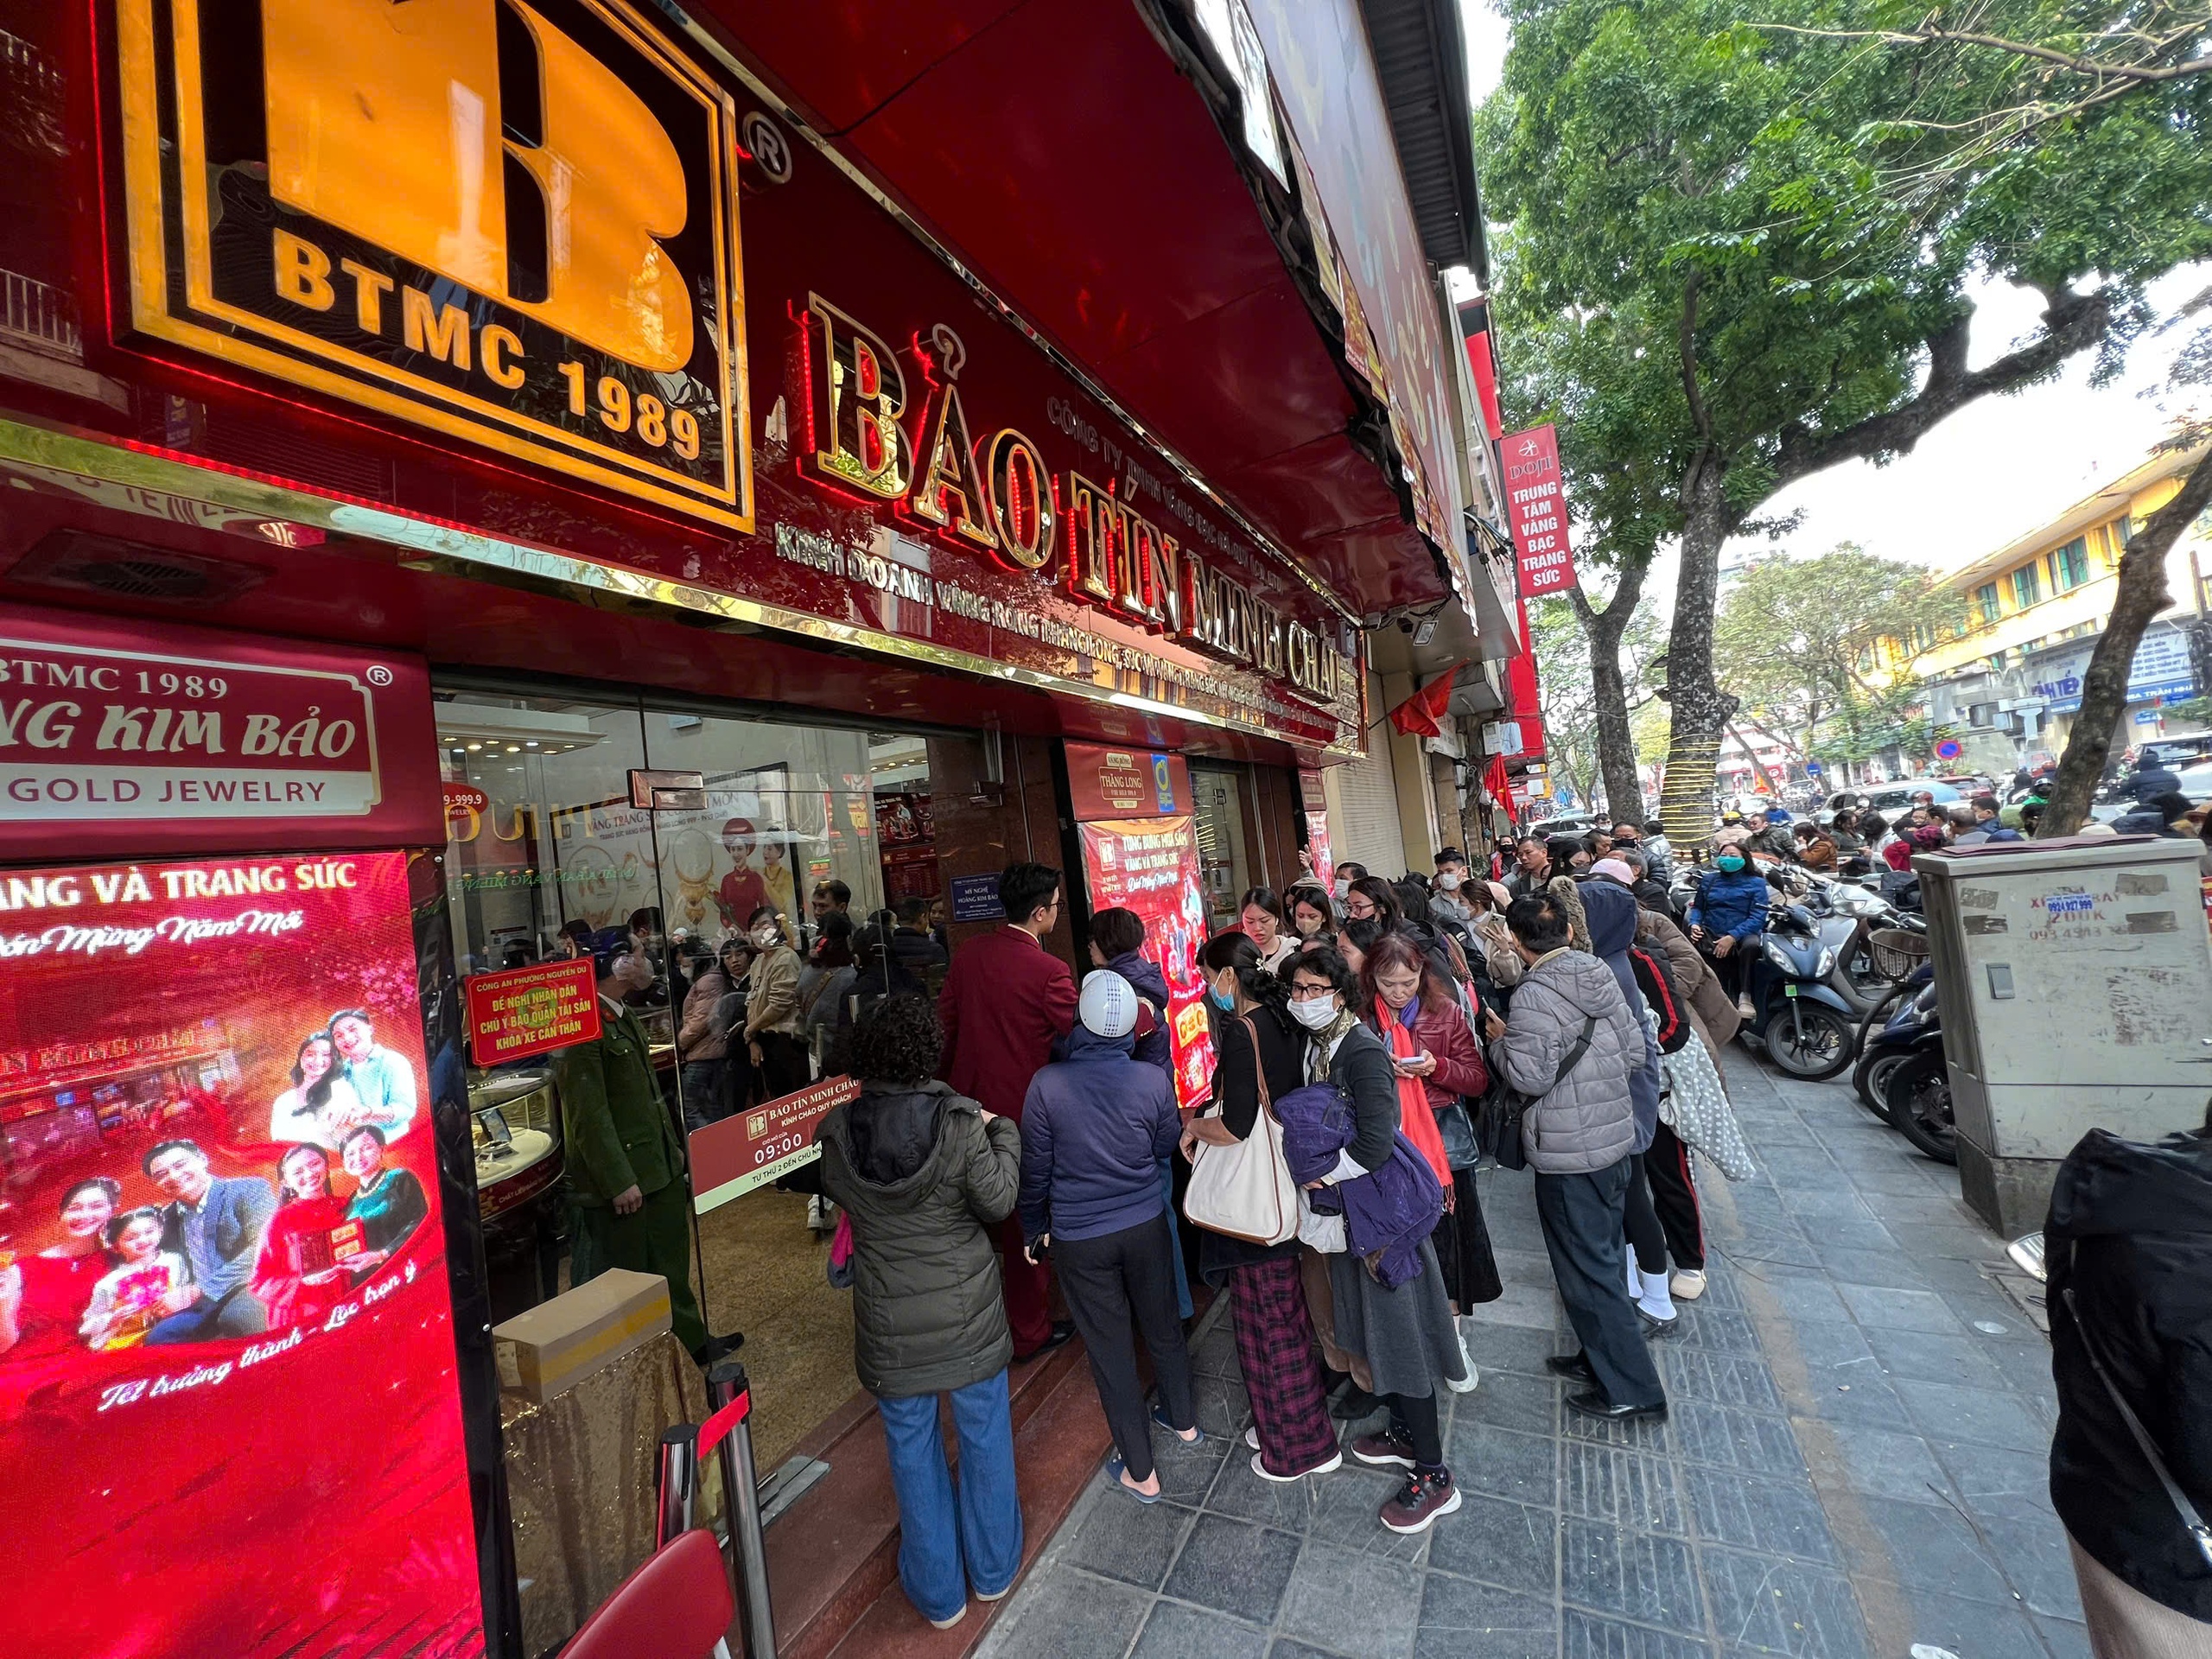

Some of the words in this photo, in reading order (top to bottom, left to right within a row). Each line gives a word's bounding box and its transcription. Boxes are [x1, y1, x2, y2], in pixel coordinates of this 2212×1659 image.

[273, 227, 525, 390] BTMC
[558, 360, 701, 461] 1989
[1046, 396, 1099, 453] CÔNG
[1101, 435, 1122, 471] TY
[1509, 455, 1554, 480] DOJI
[809, 290, 1056, 570] BẢO
[1070, 469, 1181, 632] TÍN
[1186, 549, 1285, 678] MINH
[1512, 481, 1557, 504] TRUNG
[1522, 499, 1552, 519] TÂM
[1521, 516, 1558, 537] VÀNG
[1528, 534, 1555, 554] BẠC
[774, 521, 845, 576] KINH
[848, 547, 934, 606] DOANH
[1522, 550, 1567, 572] TRANG
[1533, 568, 1560, 588] SỨC
[0, 658, 120, 691] BTMC
[135, 671, 228, 699] 1989
[96, 704, 226, 754] KIM
[241, 706, 356, 758] BẢO
[8, 778, 141, 802] GOLD
[158, 779, 326, 803] JEWELRY
[1100, 773, 1124, 788] THĂNG
[1125, 776, 1142, 789] LONG
[90, 867, 153, 903] VÀ
[159, 866, 286, 899] TRANG
[295, 858, 357, 891] SỨC
[156, 916, 238, 944] Năm
[477, 982, 499, 992] CÔNG
[532, 988, 557, 1003] NHÂN
[560, 984, 577, 997] DÂN
[480, 1020, 500, 1034] CHÚ
[502, 1016, 510, 1029] Ý
[531, 1006, 557, 1023] QUẢN
[557, 1003, 572, 1016] TÀI
[574, 998, 591, 1014] SẢN
[524, 1032, 537, 1044] XE
[558, 1020, 582, 1036] THẬN
[769, 1103, 791, 1121] BẢO
[791, 1096, 808, 1111] TÍN
[810, 1087, 834, 1103] MINH
[835, 1077, 860, 1094] CHÂU
[781, 1114, 798, 1128] KÍNH
[798, 1107, 817, 1121] CHÀO
[817, 1101, 831, 1112] QUÝ
[830, 1092, 852, 1108] KHÁCH
[754, 1133, 802, 1165] 09:00
[752, 1173, 761, 1184] TỪ
[762, 1166, 777, 1179] THỨ
[783, 1157, 797, 1169] ĐẾN
[798, 1150, 811, 1161] CHỦ
[97, 1376, 151, 1412] Tết
[238, 1326, 302, 1369] thành
[323, 1300, 359, 1332] Lộc
[365, 1274, 400, 1306] trọn
